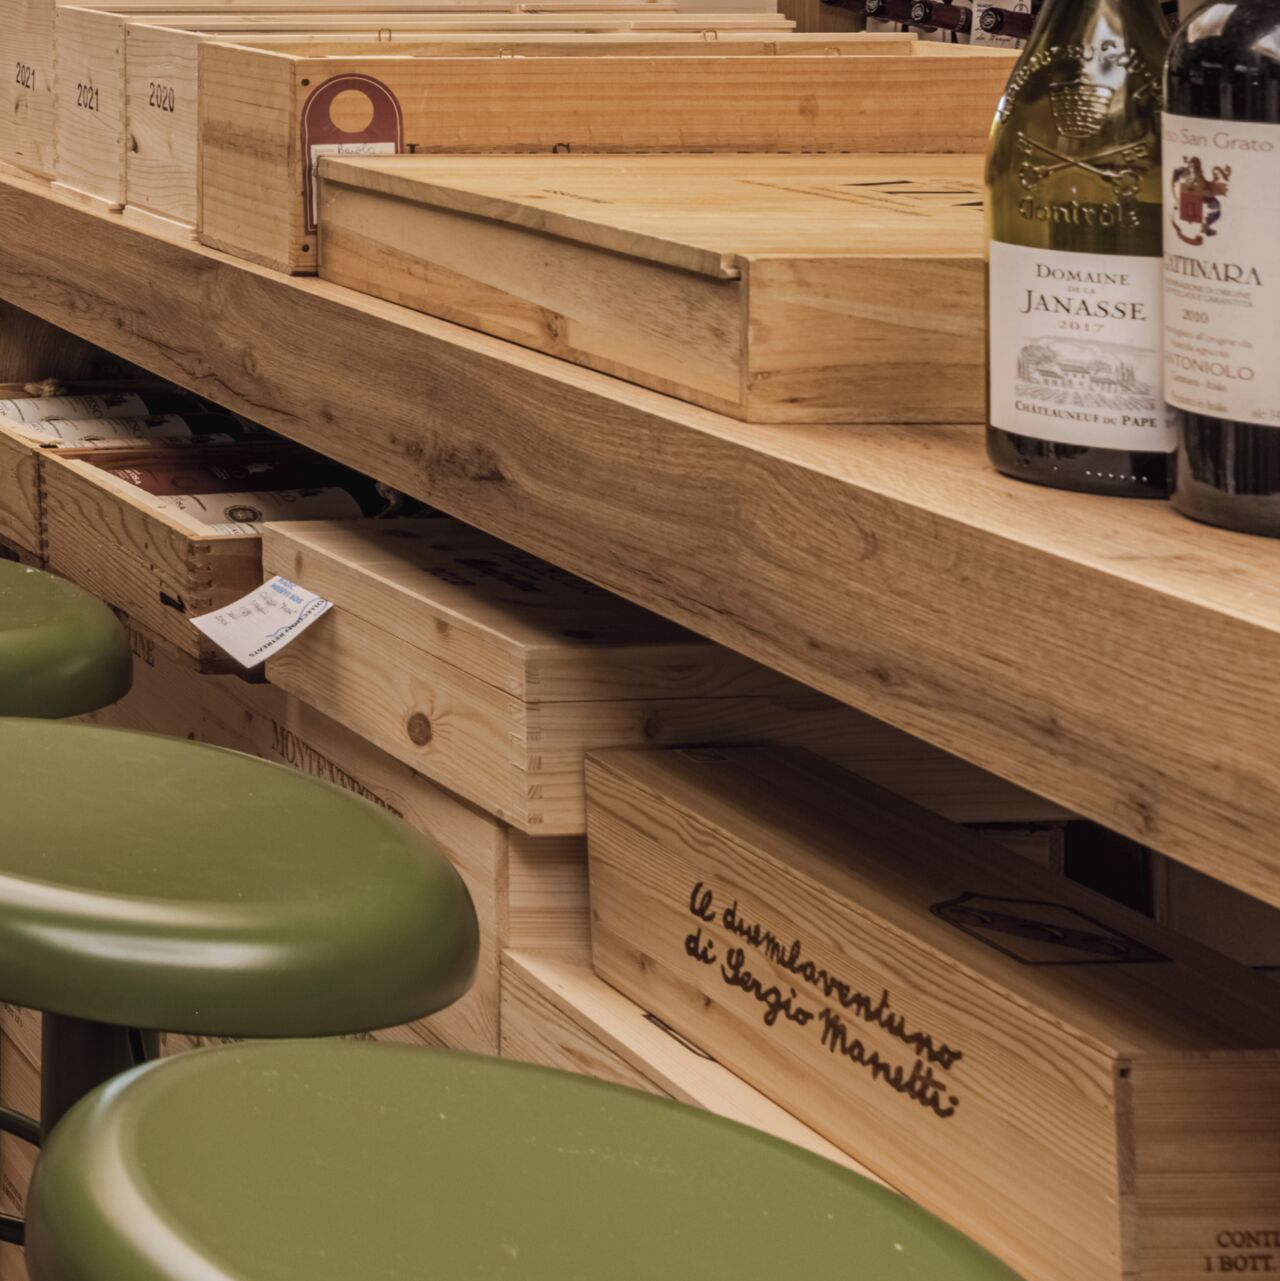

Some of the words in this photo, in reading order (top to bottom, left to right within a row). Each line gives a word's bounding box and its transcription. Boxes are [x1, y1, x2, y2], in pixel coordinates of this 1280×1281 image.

[16, 62, 35, 91] 2021
[77, 83, 99, 112] 2021
[149, 82, 175, 113] 2020
[1181, 129, 1208, 147] San
[1212, 132, 1275, 154] Grato
[1018, 289, 1147, 321] JANASSE
[1058, 320, 1105, 333] 2017
[1122, 416, 1158, 428] PAPE
[684, 927, 716, 964] di
[721, 948, 814, 1026] Sergio
